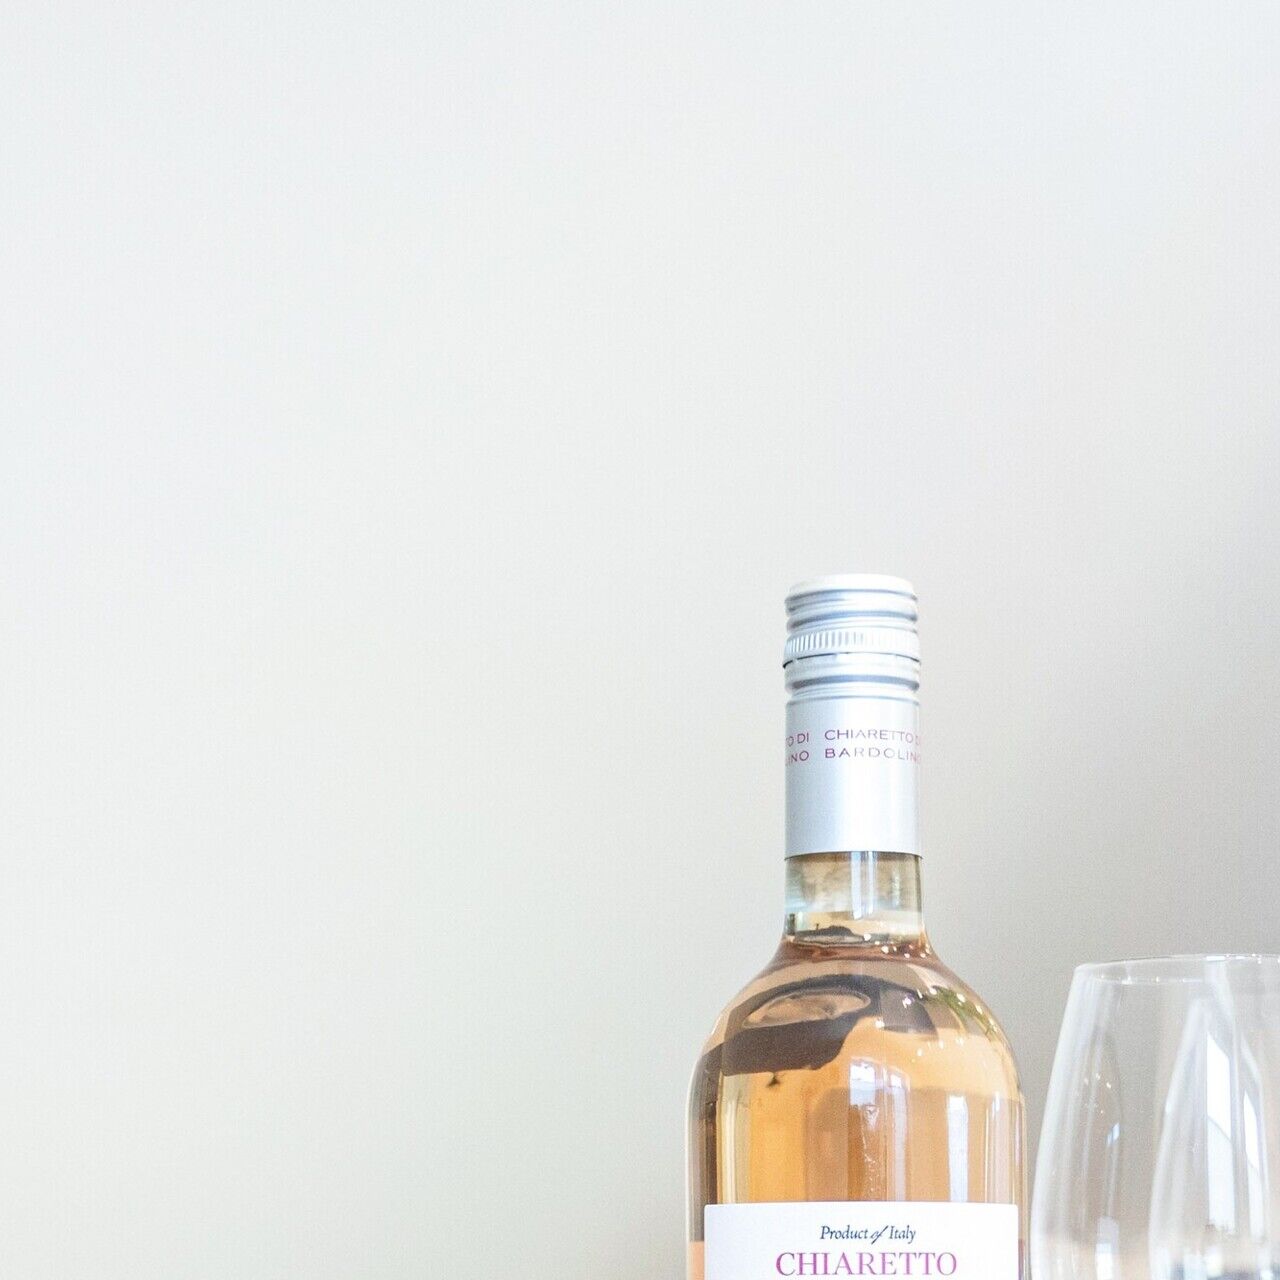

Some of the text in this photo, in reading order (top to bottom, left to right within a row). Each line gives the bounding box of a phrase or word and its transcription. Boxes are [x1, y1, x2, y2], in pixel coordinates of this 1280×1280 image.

[797, 732, 809, 744] DI
[825, 729, 913, 743] CHIARETTO
[820, 1225, 916, 1244] Product of Italy
[776, 1252, 957, 1276] CHIARETTO
